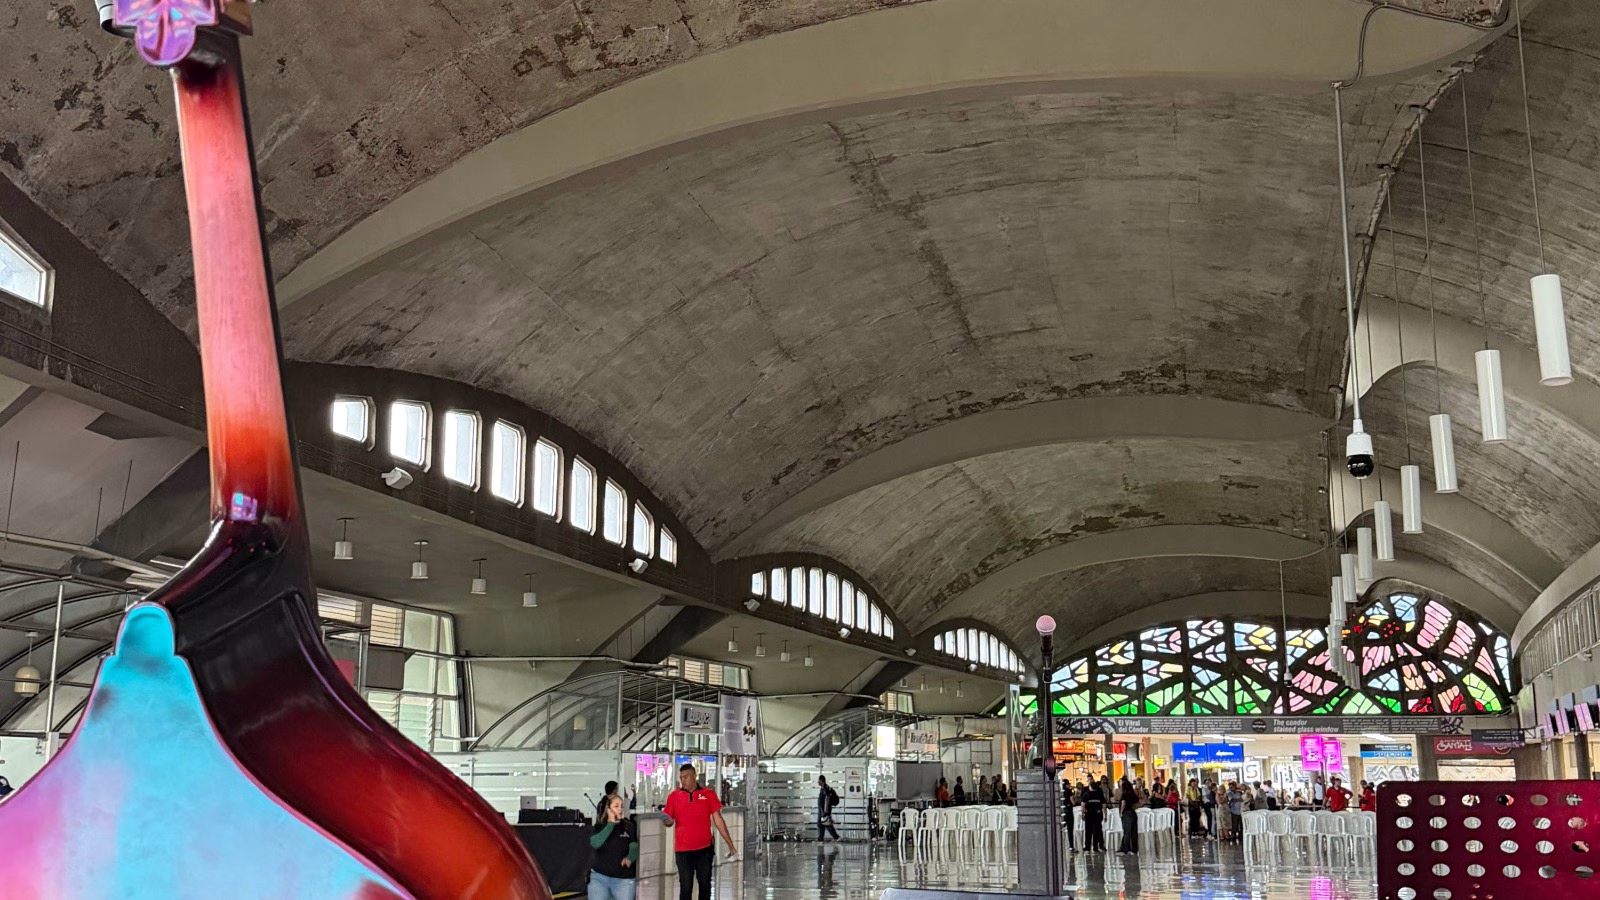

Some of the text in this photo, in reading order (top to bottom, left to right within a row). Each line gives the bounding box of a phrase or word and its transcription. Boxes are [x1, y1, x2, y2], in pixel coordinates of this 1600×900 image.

[1118, 719, 1125, 727] El
[1125, 719, 1141, 727] Vitral
[1297, 726, 1314, 735] glass
